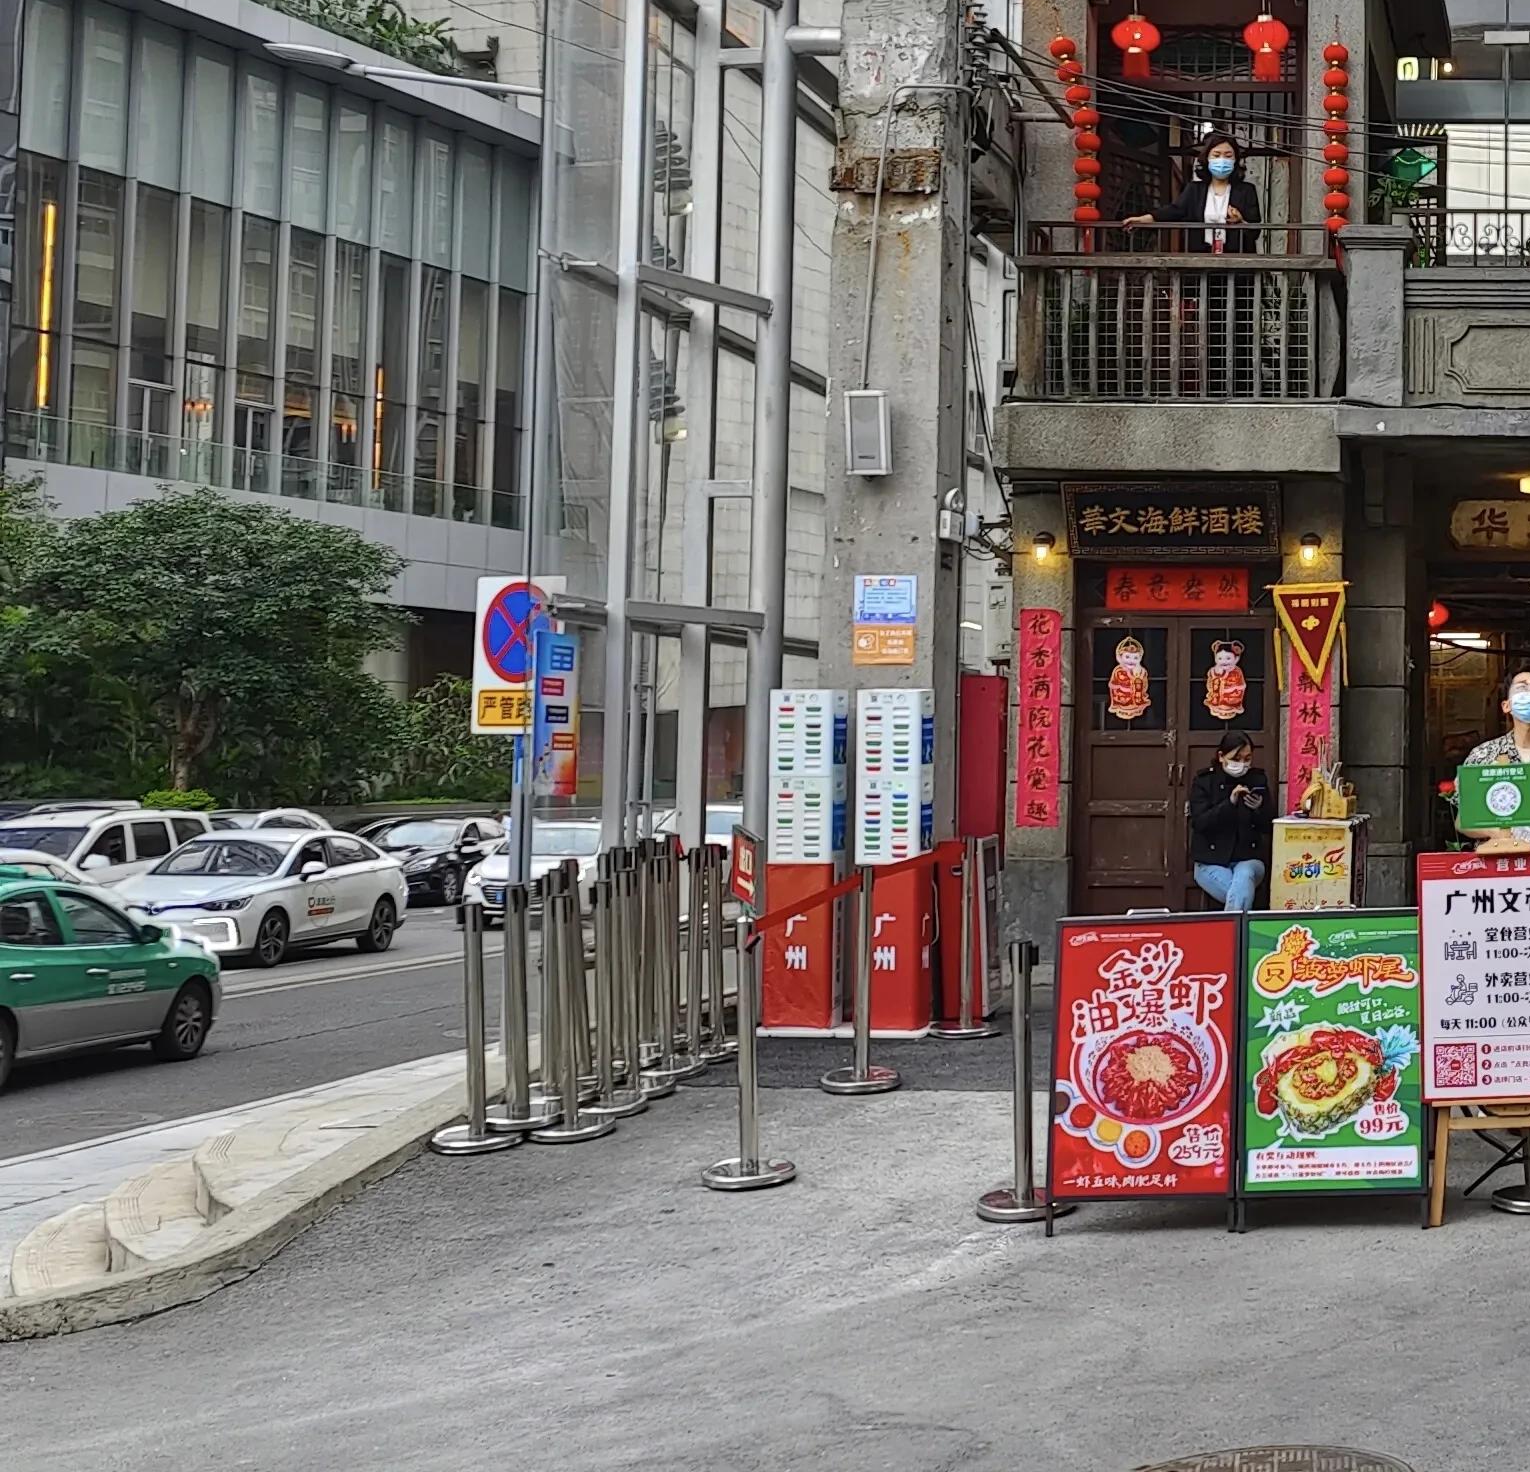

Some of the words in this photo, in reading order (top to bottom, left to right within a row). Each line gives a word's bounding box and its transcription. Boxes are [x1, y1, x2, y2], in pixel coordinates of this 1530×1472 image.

[1078, 504, 1265, 537] 華文海鮮酒楼
[785, 914, 808, 971] 广州
[873, 913, 896, 971] 广州
[1440, 1018, 1462, 1030] 每天
[1465, 1017, 1497, 1029] 11:00
[1373, 1102, 1399, 1116] 售价
[1186, 1127, 1221, 1142] 售价
[1360, 1116, 1404, 1135] 99元
